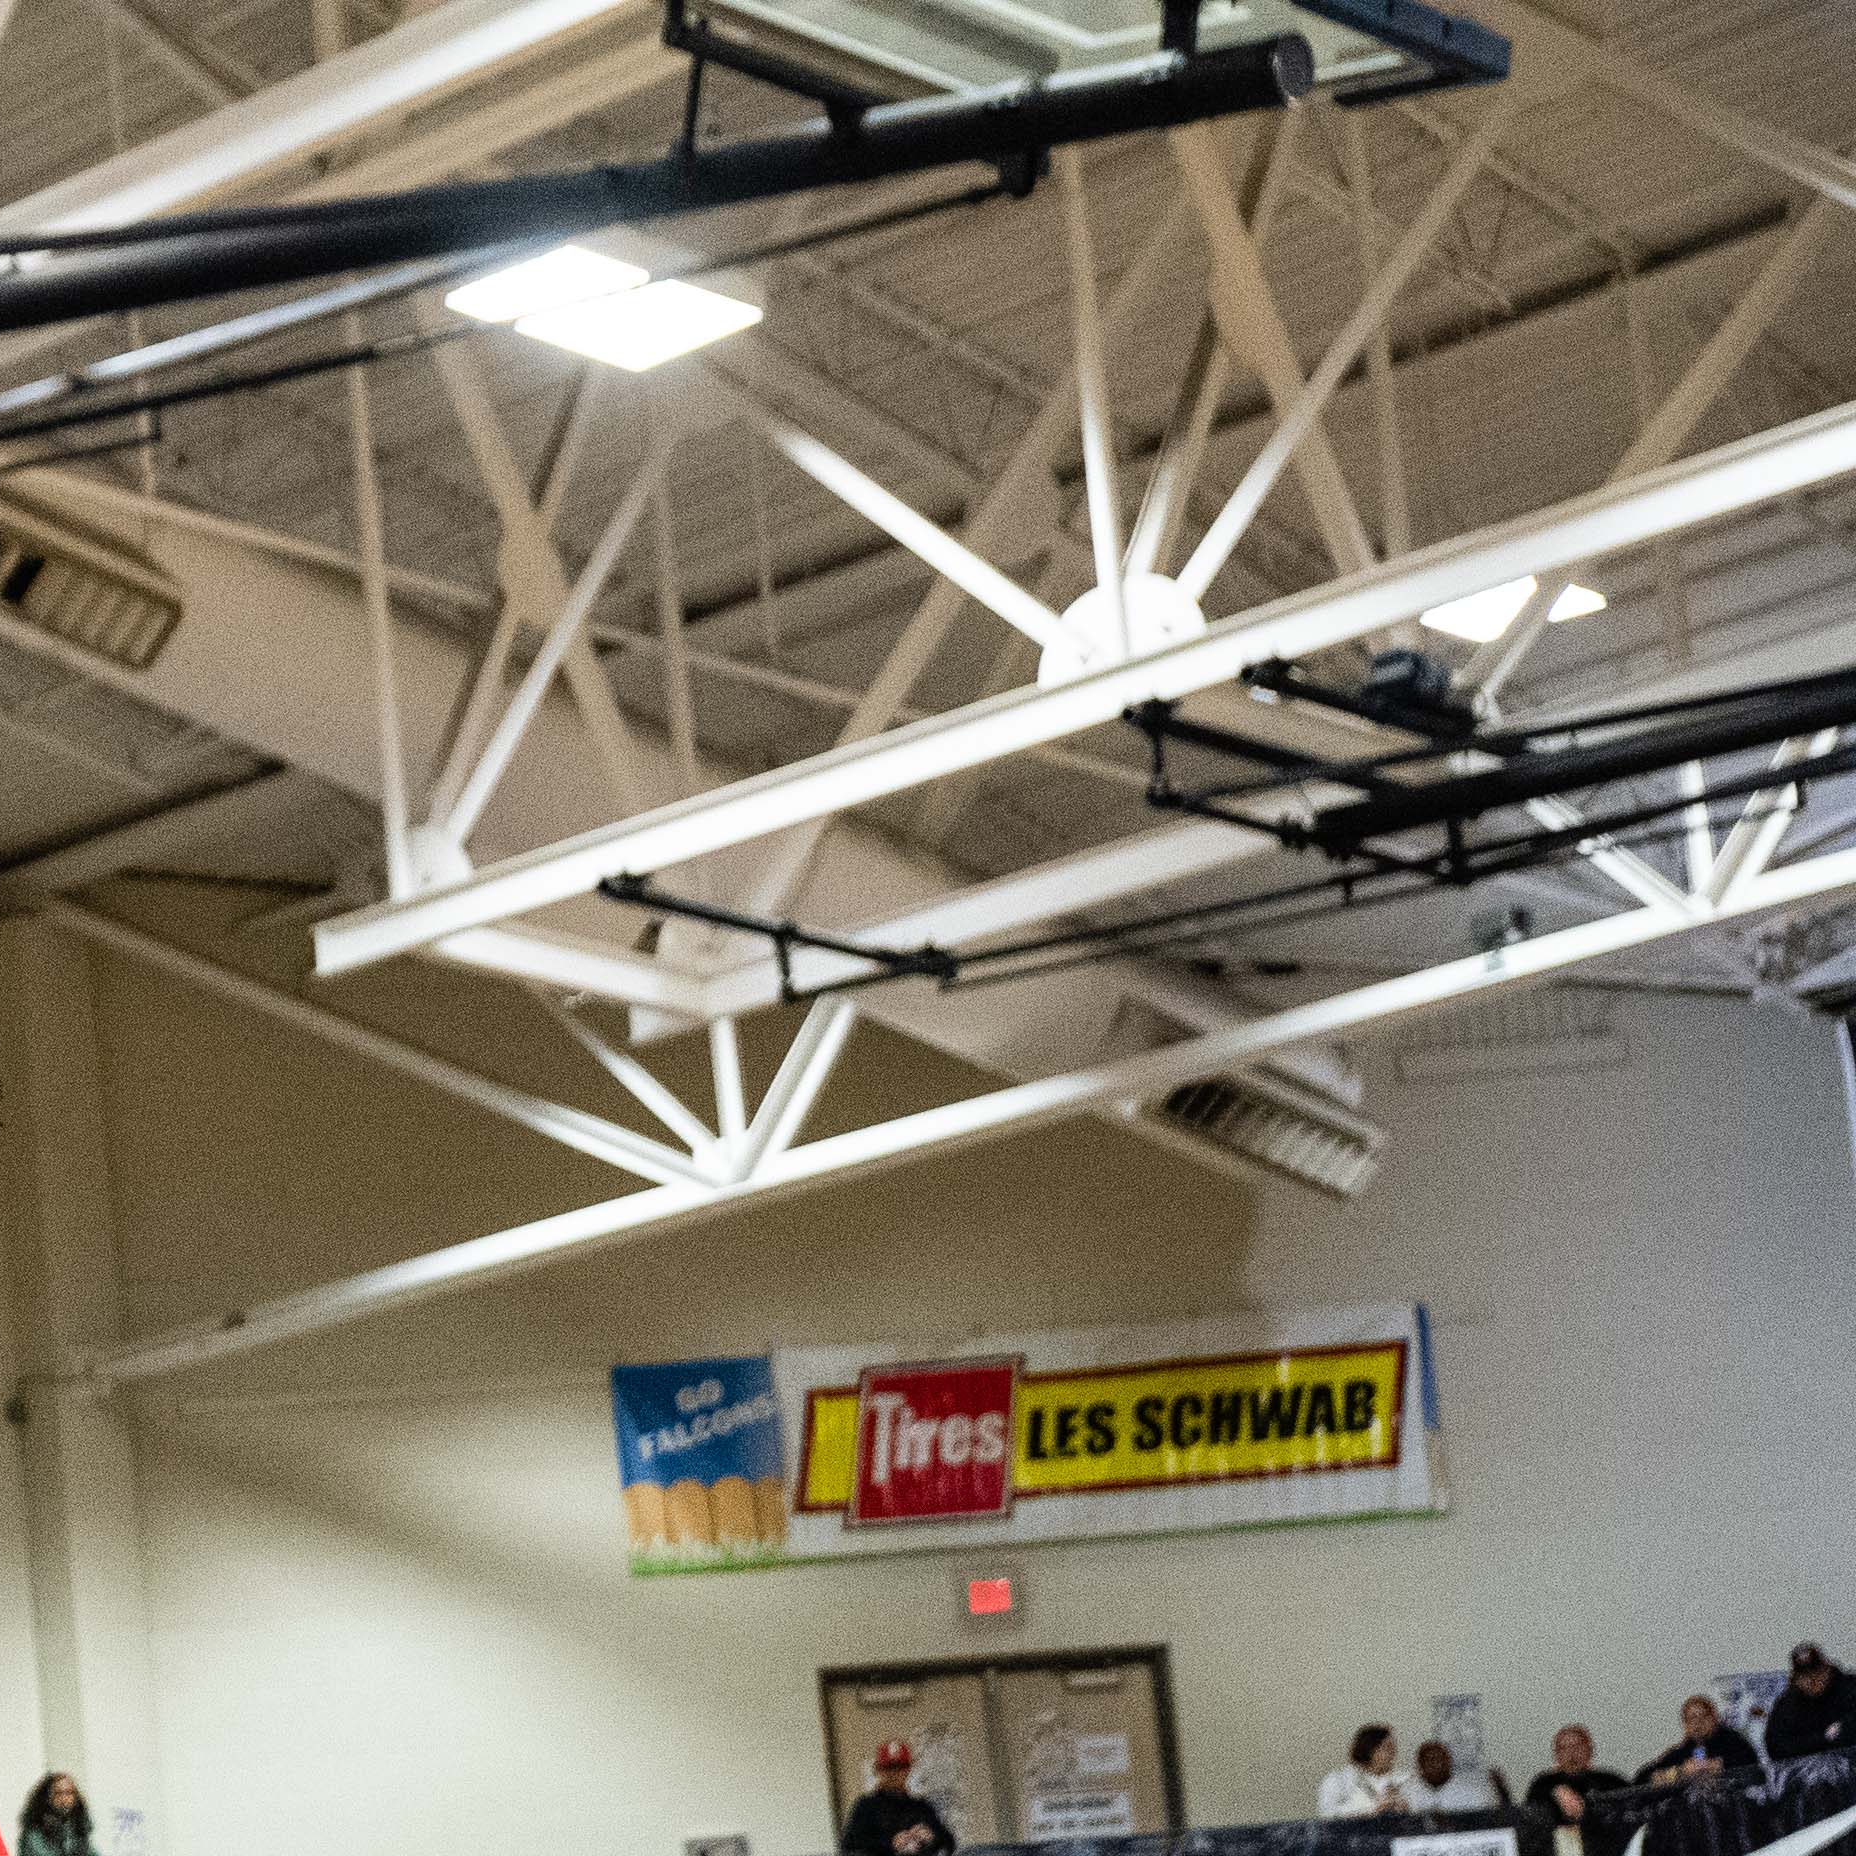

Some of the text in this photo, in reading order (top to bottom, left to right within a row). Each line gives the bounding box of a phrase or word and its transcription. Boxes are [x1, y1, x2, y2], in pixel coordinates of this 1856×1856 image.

[868, 1377, 1377, 1486] Tires LES SCHWAB
